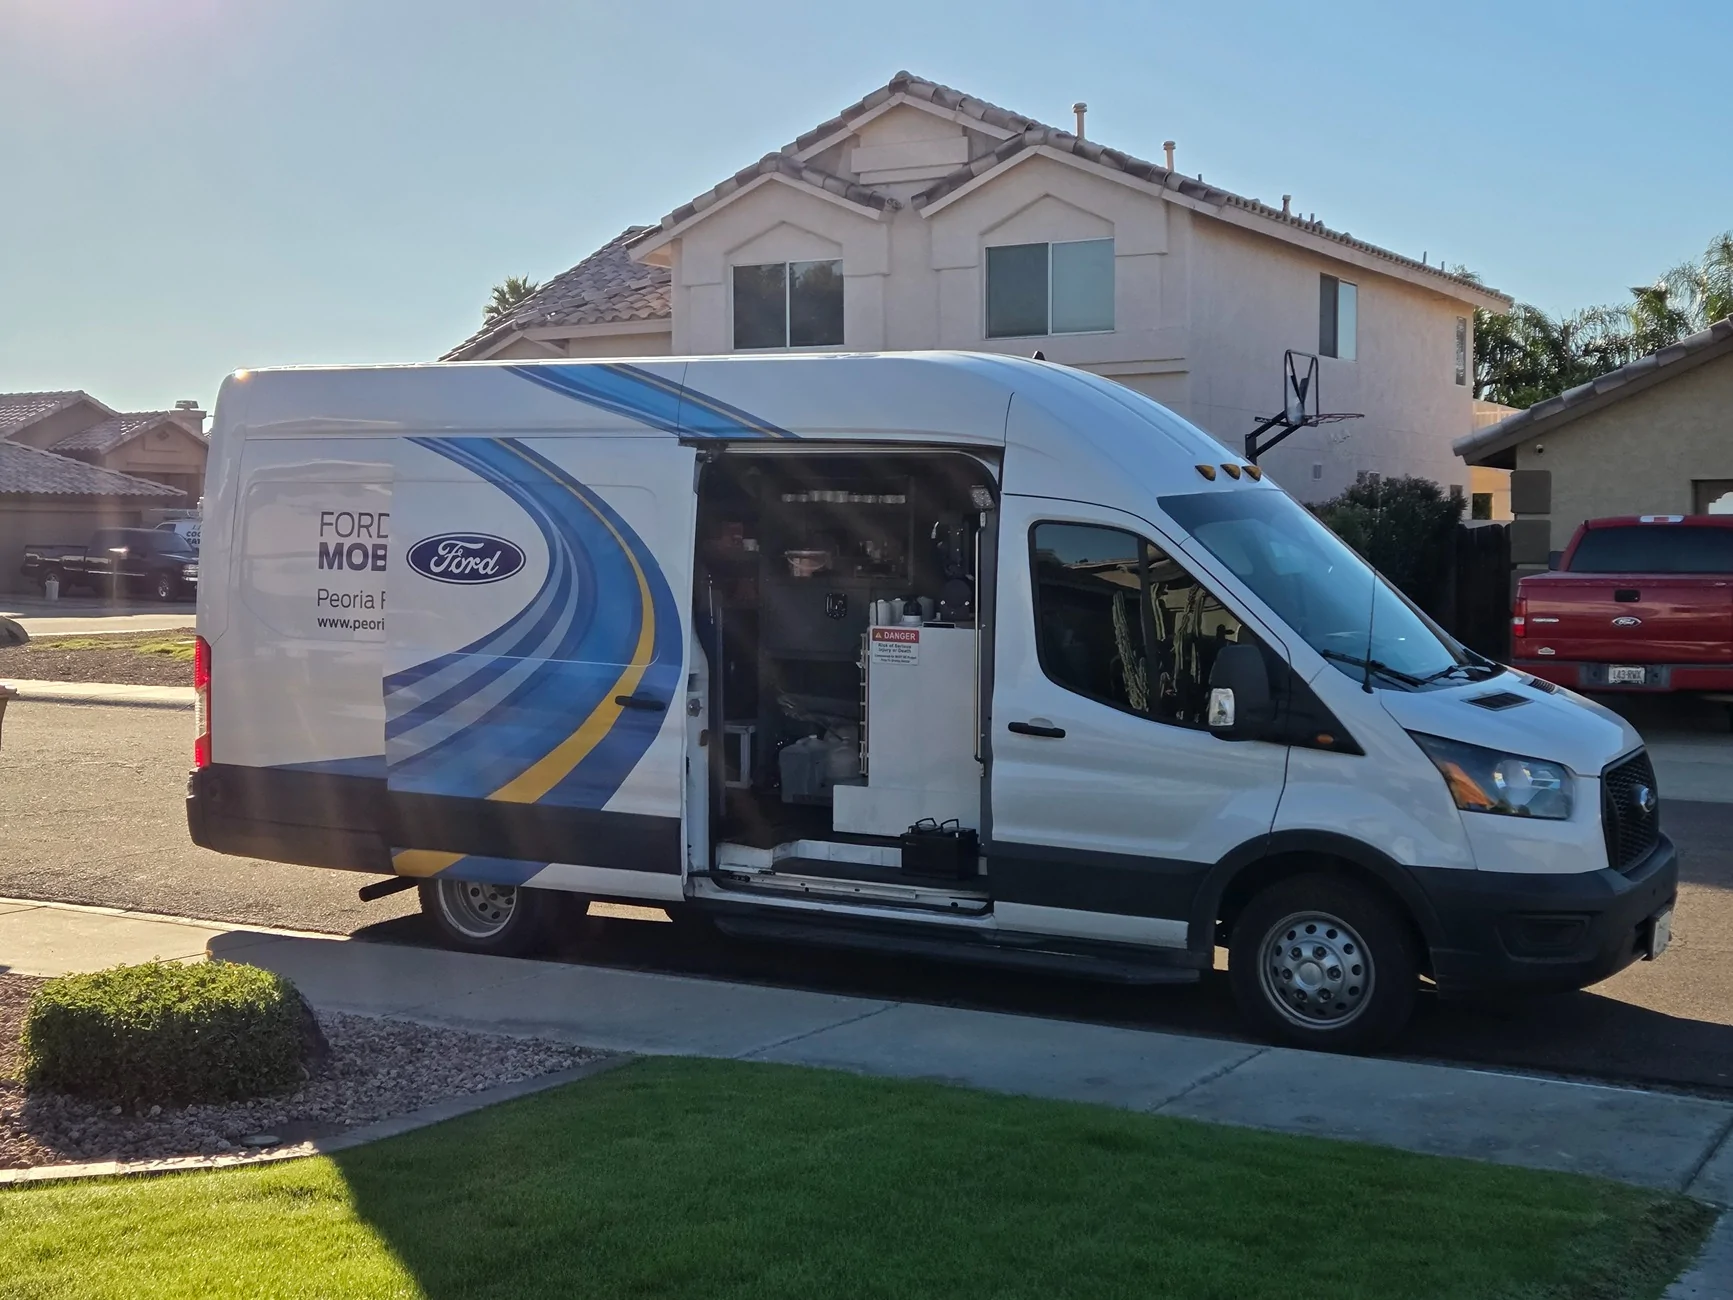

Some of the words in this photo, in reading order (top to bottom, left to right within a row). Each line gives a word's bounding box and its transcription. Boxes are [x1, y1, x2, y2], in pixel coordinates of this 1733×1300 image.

[320, 511, 390, 538] FORD
[318, 542, 388, 571] MOB
[430, 540, 502, 575] Ford
[317, 588, 375, 610] Peoria
[317, 617, 385, 631] www.peori
[884, 631, 916, 640] DANGER
